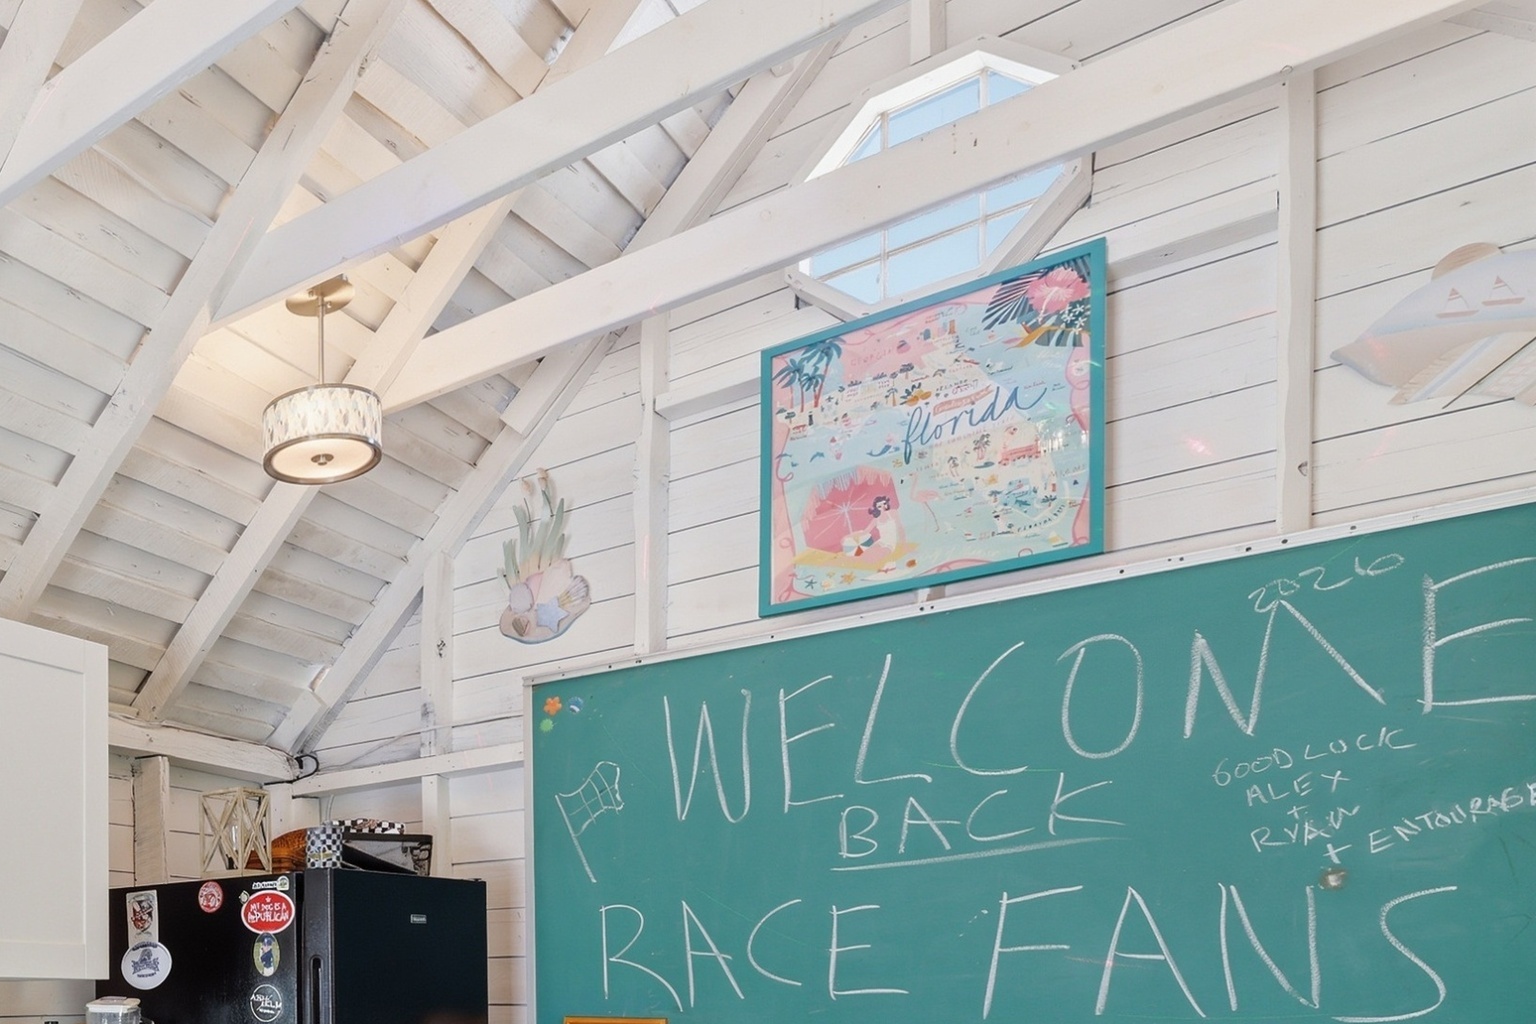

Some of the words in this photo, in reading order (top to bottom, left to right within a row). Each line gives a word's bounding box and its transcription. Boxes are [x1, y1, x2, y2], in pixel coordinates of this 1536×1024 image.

[902, 386, 1047, 465] florida
[1248, 553, 1405, 613] 2026
[662, 556, 1536, 822] WELCOME
[1212, 748, 1293, 787] GOOD
[1304, 727, 1417, 760] LUCK
[840, 772, 1126, 859] BACK
[1246, 770, 1350, 806] ALEX
[1250, 805, 1360, 852] RYAN
[247, 910, 289, 923] REPUBLICAN
[600, 899, 909, 1013] RACE
[982, 884, 1458, 1023] FANS
